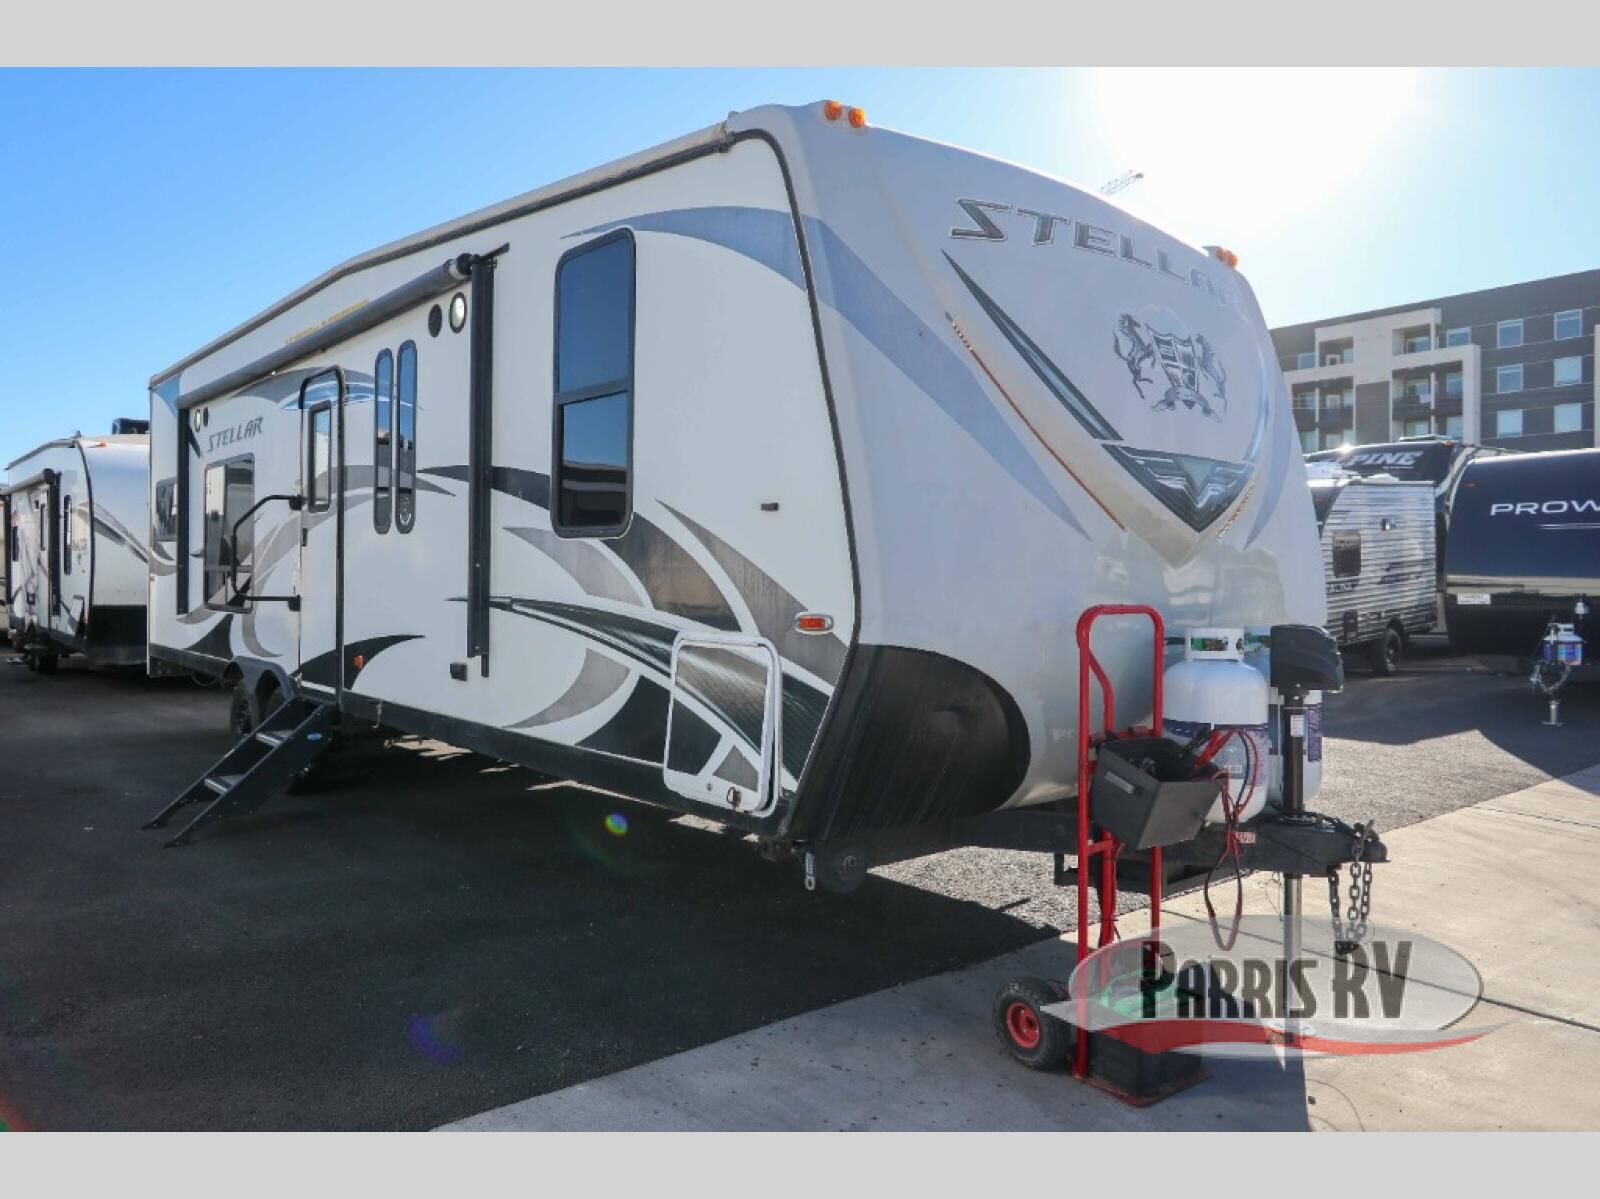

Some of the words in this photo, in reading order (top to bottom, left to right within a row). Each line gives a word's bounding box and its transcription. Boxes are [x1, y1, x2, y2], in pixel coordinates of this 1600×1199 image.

[949, 197, 1240, 306] STELLAR
[206, 416, 263, 453] STELLAR
[1341, 451, 1425, 467] PINE
[1489, 499, 1600, 516] PROW
